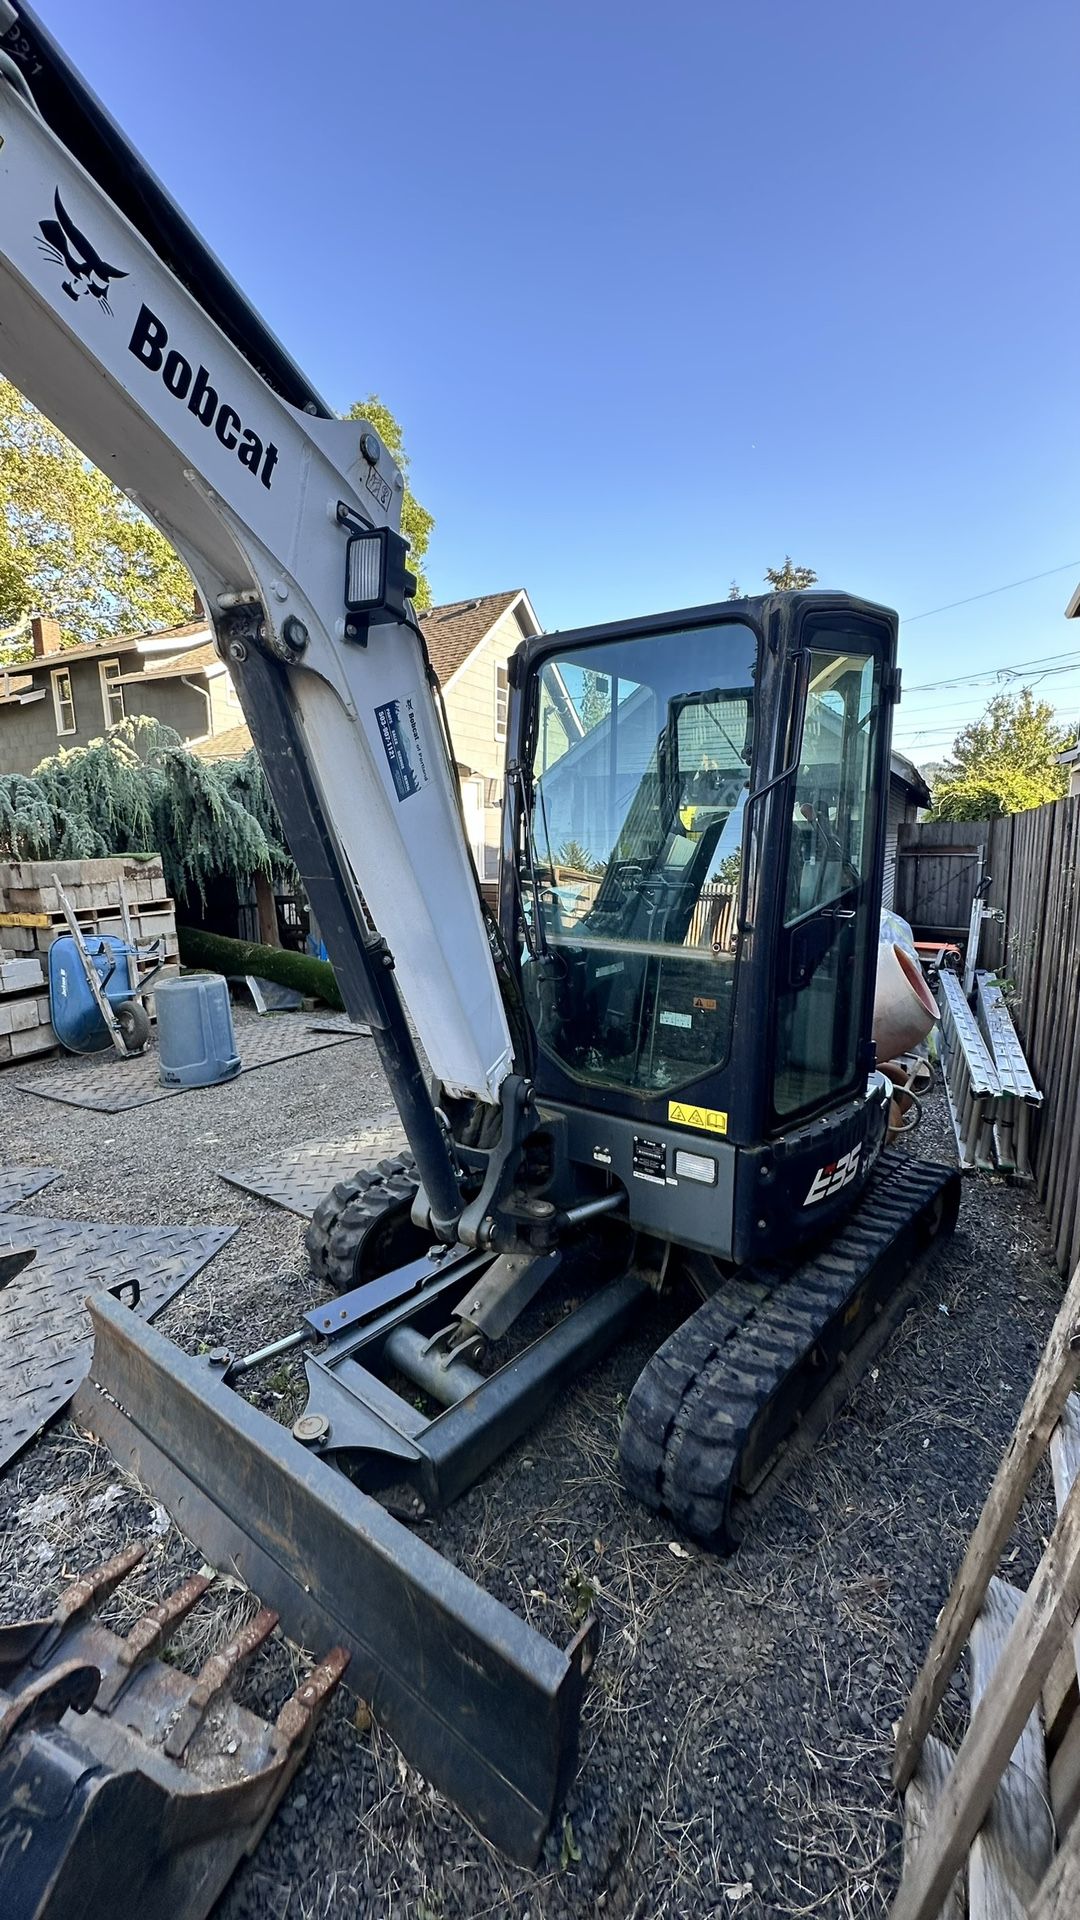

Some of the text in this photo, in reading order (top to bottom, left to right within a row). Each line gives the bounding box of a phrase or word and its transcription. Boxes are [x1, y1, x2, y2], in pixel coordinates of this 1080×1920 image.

[128, 302, 279, 491] Bobcat
[408, 712, 420, 741] Bobcat
[418, 752, 429, 782] Portland
[803, 1141, 863, 1206] E35
